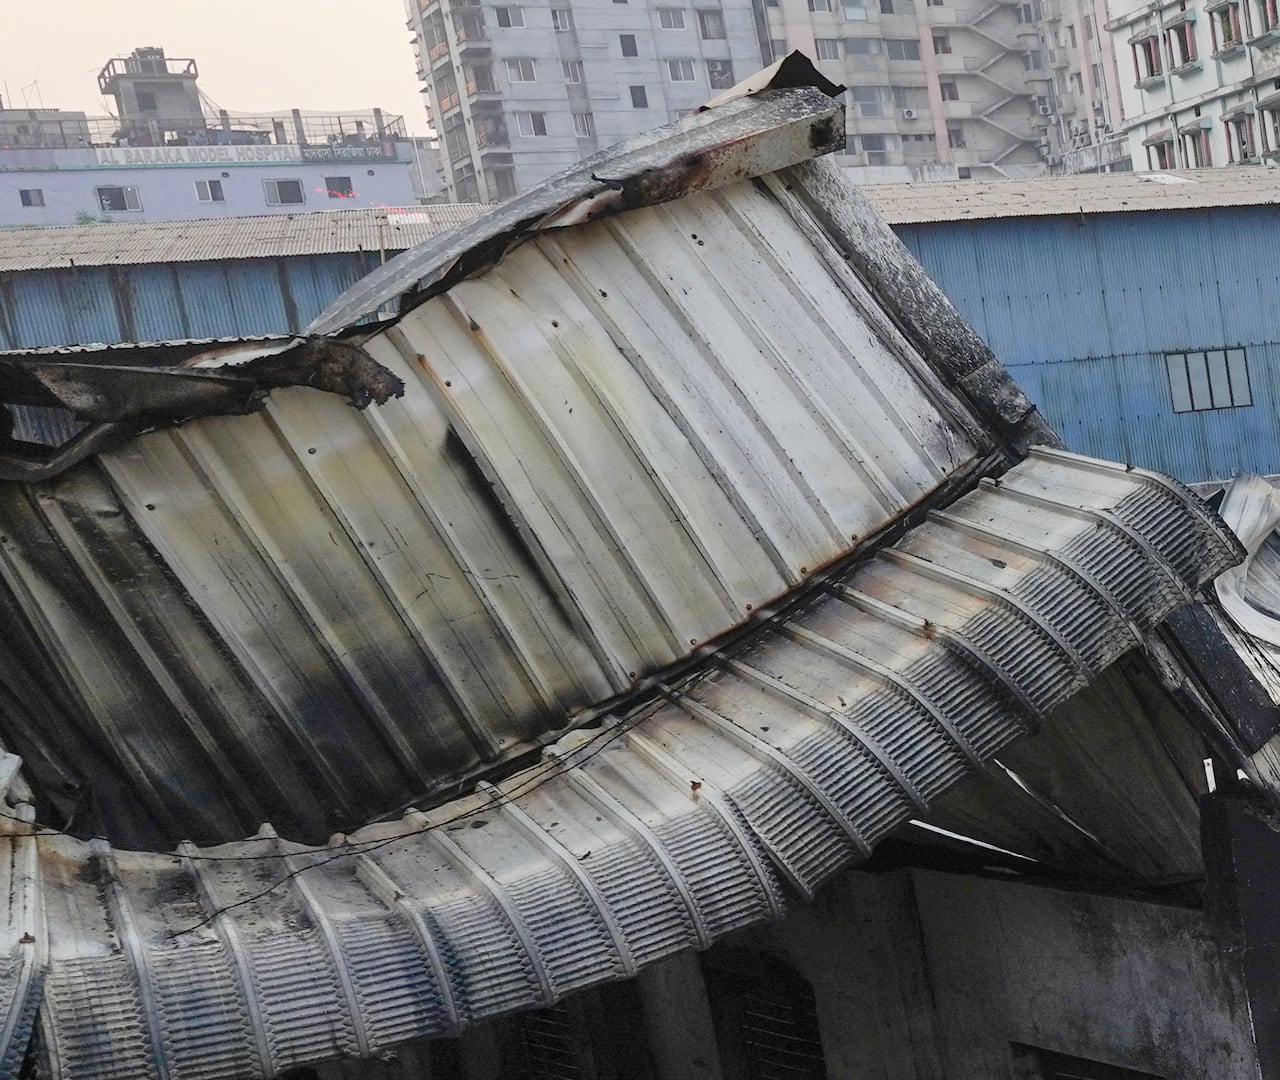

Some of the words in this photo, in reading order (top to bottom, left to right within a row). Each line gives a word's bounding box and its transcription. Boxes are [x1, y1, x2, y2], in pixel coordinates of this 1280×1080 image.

[123, 148, 184, 164] BARAKA
[187, 147, 234, 163] MODEL
[235, 145, 300, 161] HOSPITAL
